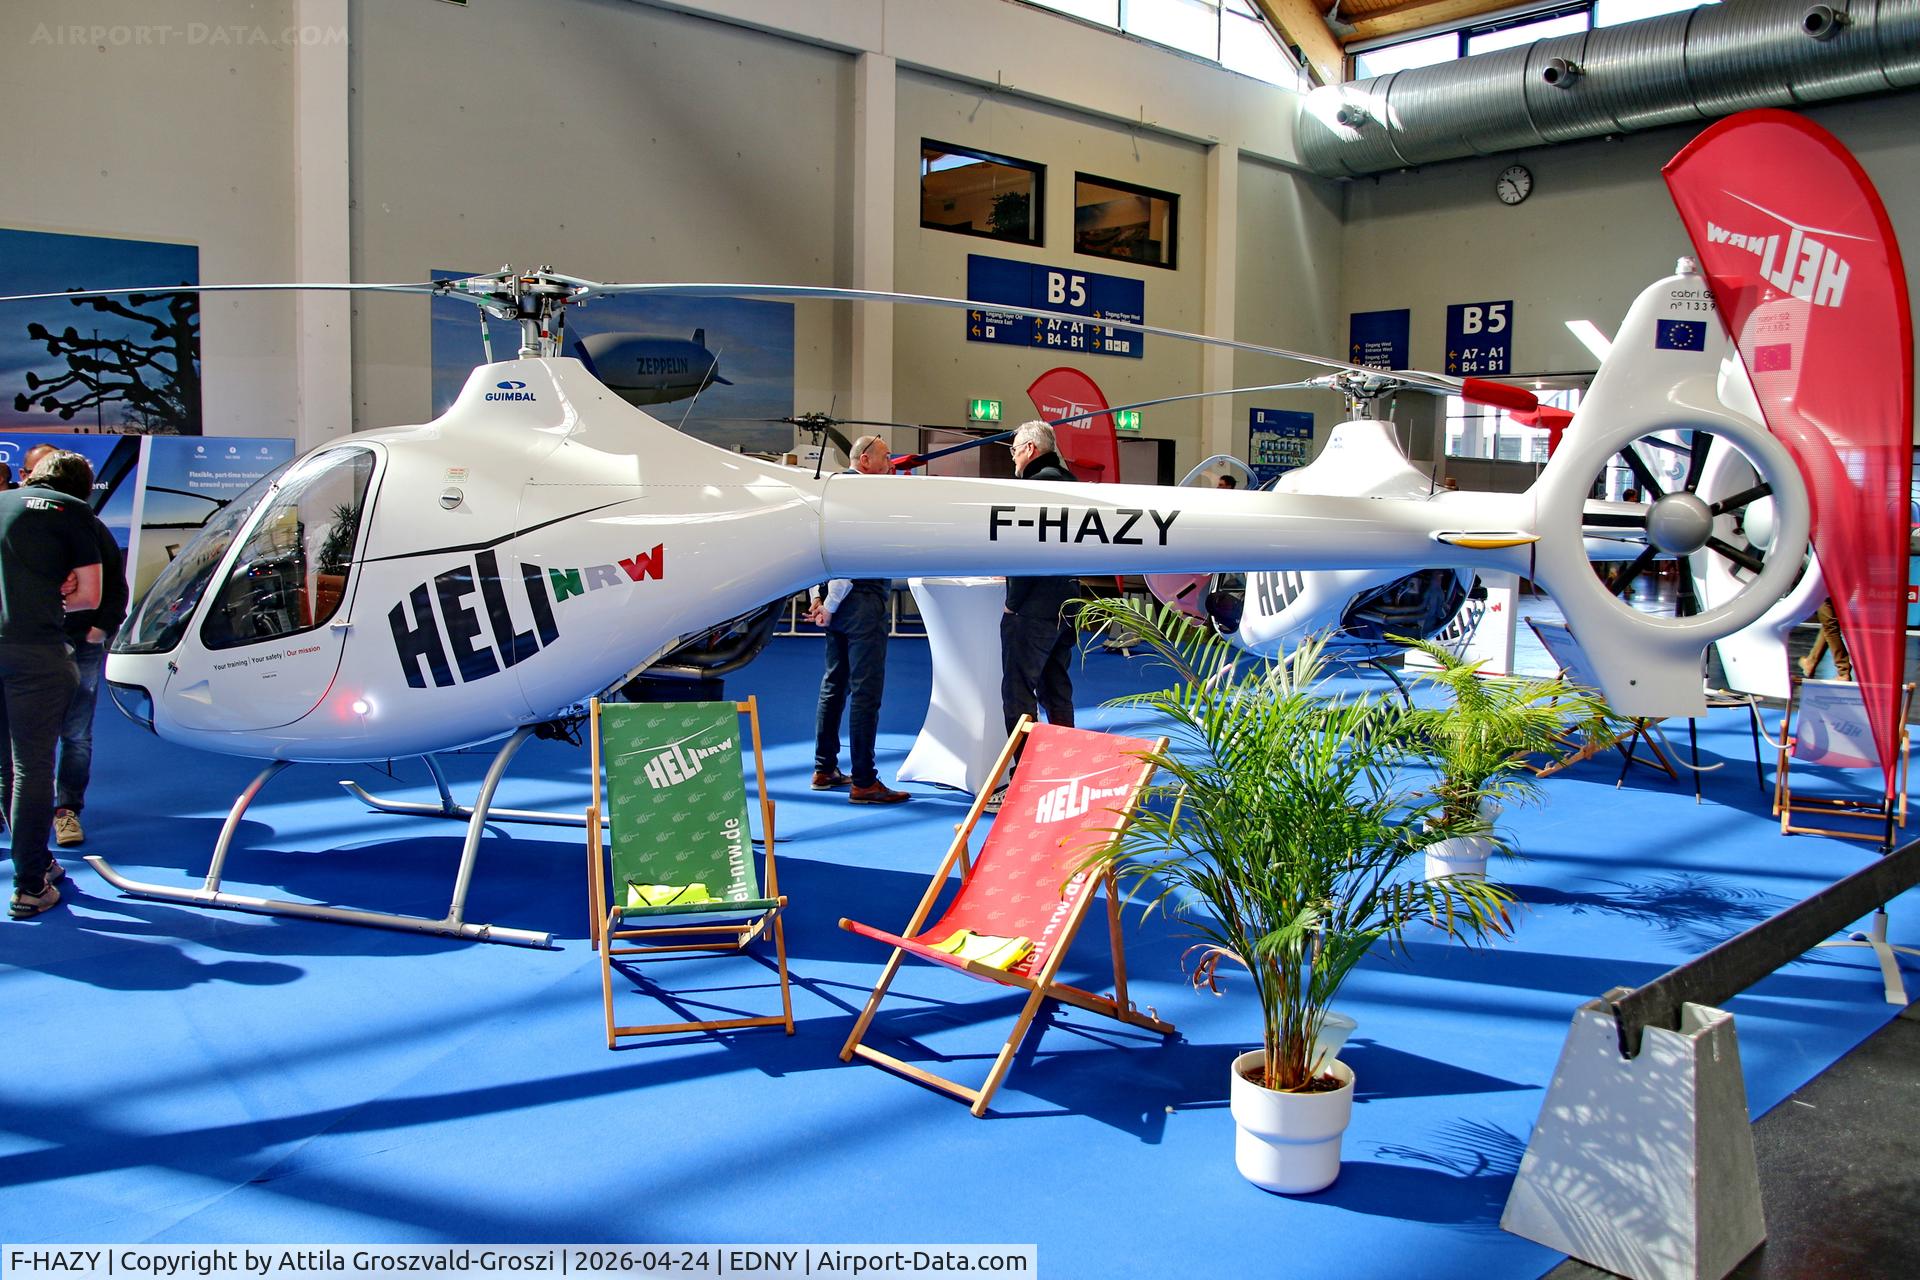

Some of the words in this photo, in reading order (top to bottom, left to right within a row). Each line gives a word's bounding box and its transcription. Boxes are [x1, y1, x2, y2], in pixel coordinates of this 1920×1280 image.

[1048, 271, 1086, 307] B5
[1670, 290, 1700, 298] cabri
[1047, 318, 1062, 331] A7
[1071, 321, 1084, 333] A1
[1463, 304, 1506, 334] B5
[1047, 333, 1061, 345] B4
[1071, 335, 1084, 348] B1
[1462, 348, 1478, 360] A7
[1488, 346, 1504, 358] A1
[636, 357, 689, 375] ZEPPELIN
[1462, 361, 1477, 372] B4
[1488, 359, 1503, 371] B1
[485, 392, 537, 402] GUIMBAL
[989, 505, 1181, 546] F-HAZY
[388, 549, 560, 689] HELI
[548, 542, 664, 603] NRW
[213, 663, 226, 671] Your
[227, 659, 248, 669] training
[251, 656, 265, 664] Your
[265, 651, 282, 660] safety
[286, 649, 297, 657] Our
[298, 645, 321, 655] mission
[643, 744, 703, 789] HELI
[1035, 780, 1090, 824] HELI
[720, 817, 749, 902] eli-nrw.de
